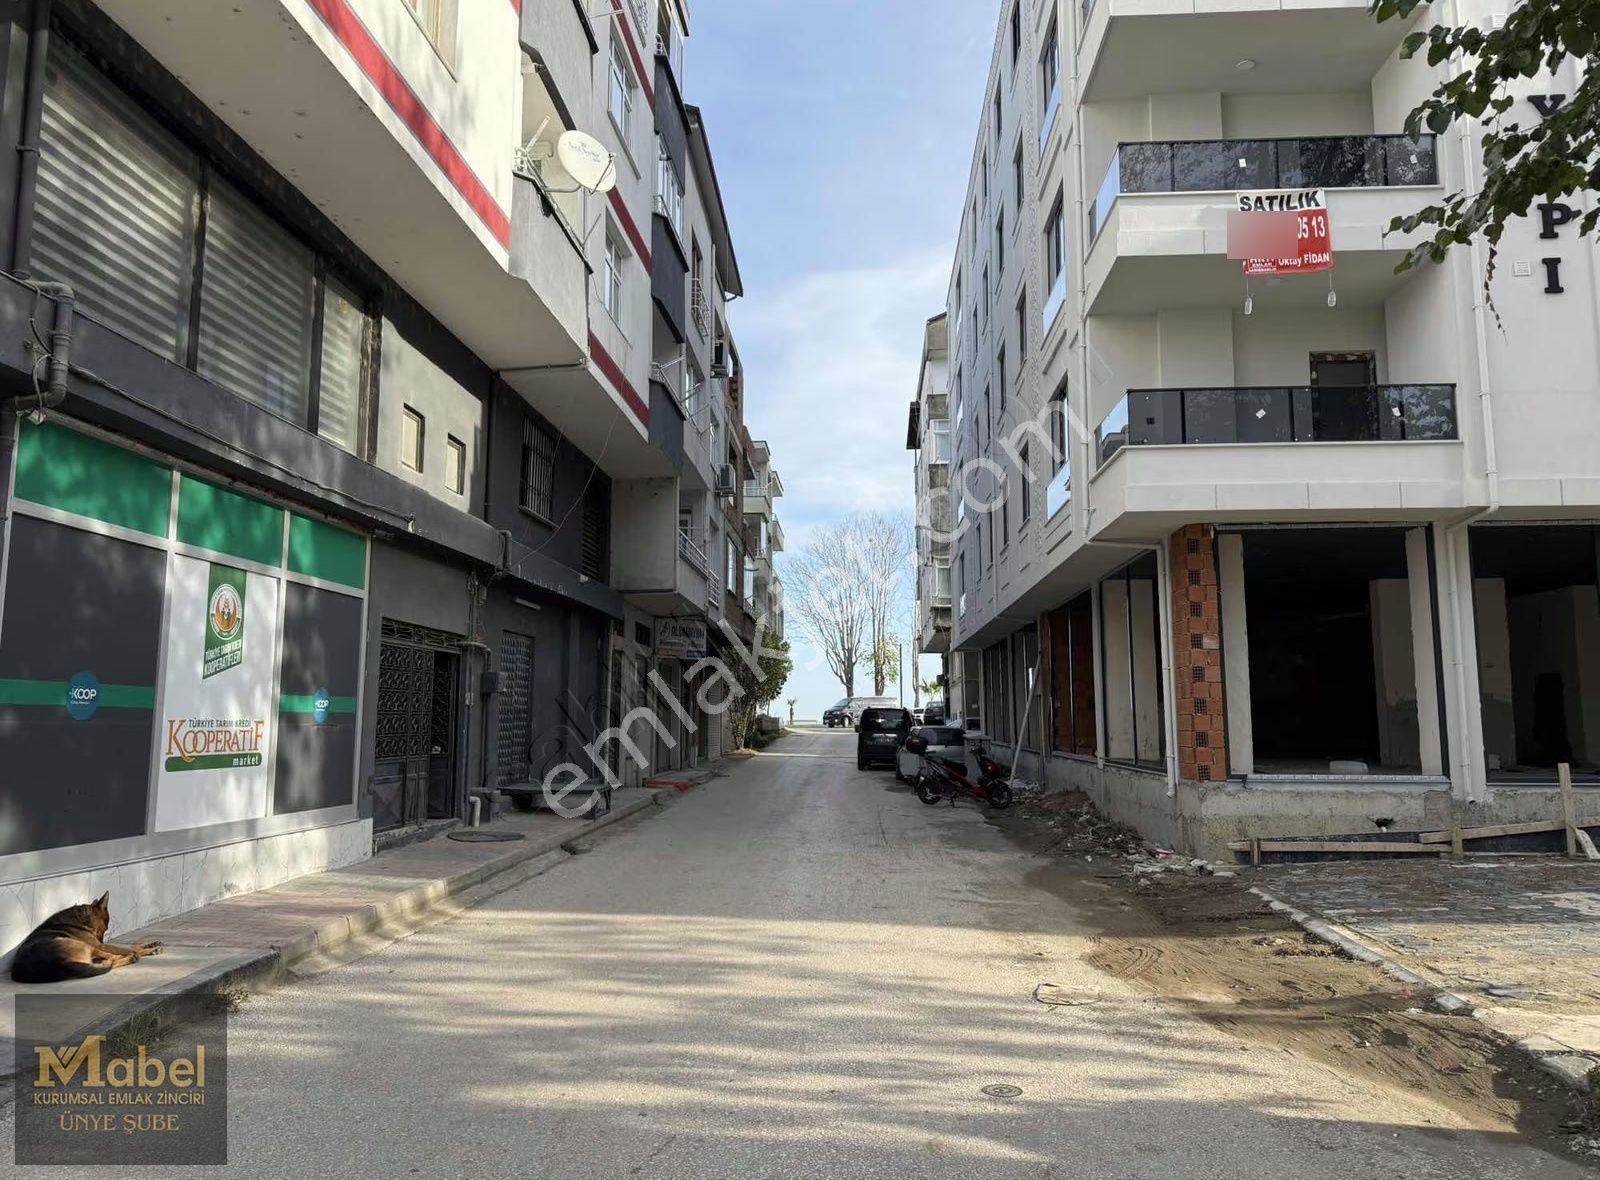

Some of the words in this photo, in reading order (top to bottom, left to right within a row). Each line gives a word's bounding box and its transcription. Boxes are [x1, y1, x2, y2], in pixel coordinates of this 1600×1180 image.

[1240, 190, 1321, 212] SATILIK
[1311, 215, 1326, 239] 13
[1304, 251, 1330, 264] FİDAN
[188, 717, 214, 728] TÜRKİYE
[215, 718, 233, 728] TARIM
[232, 755, 259, 766] market
